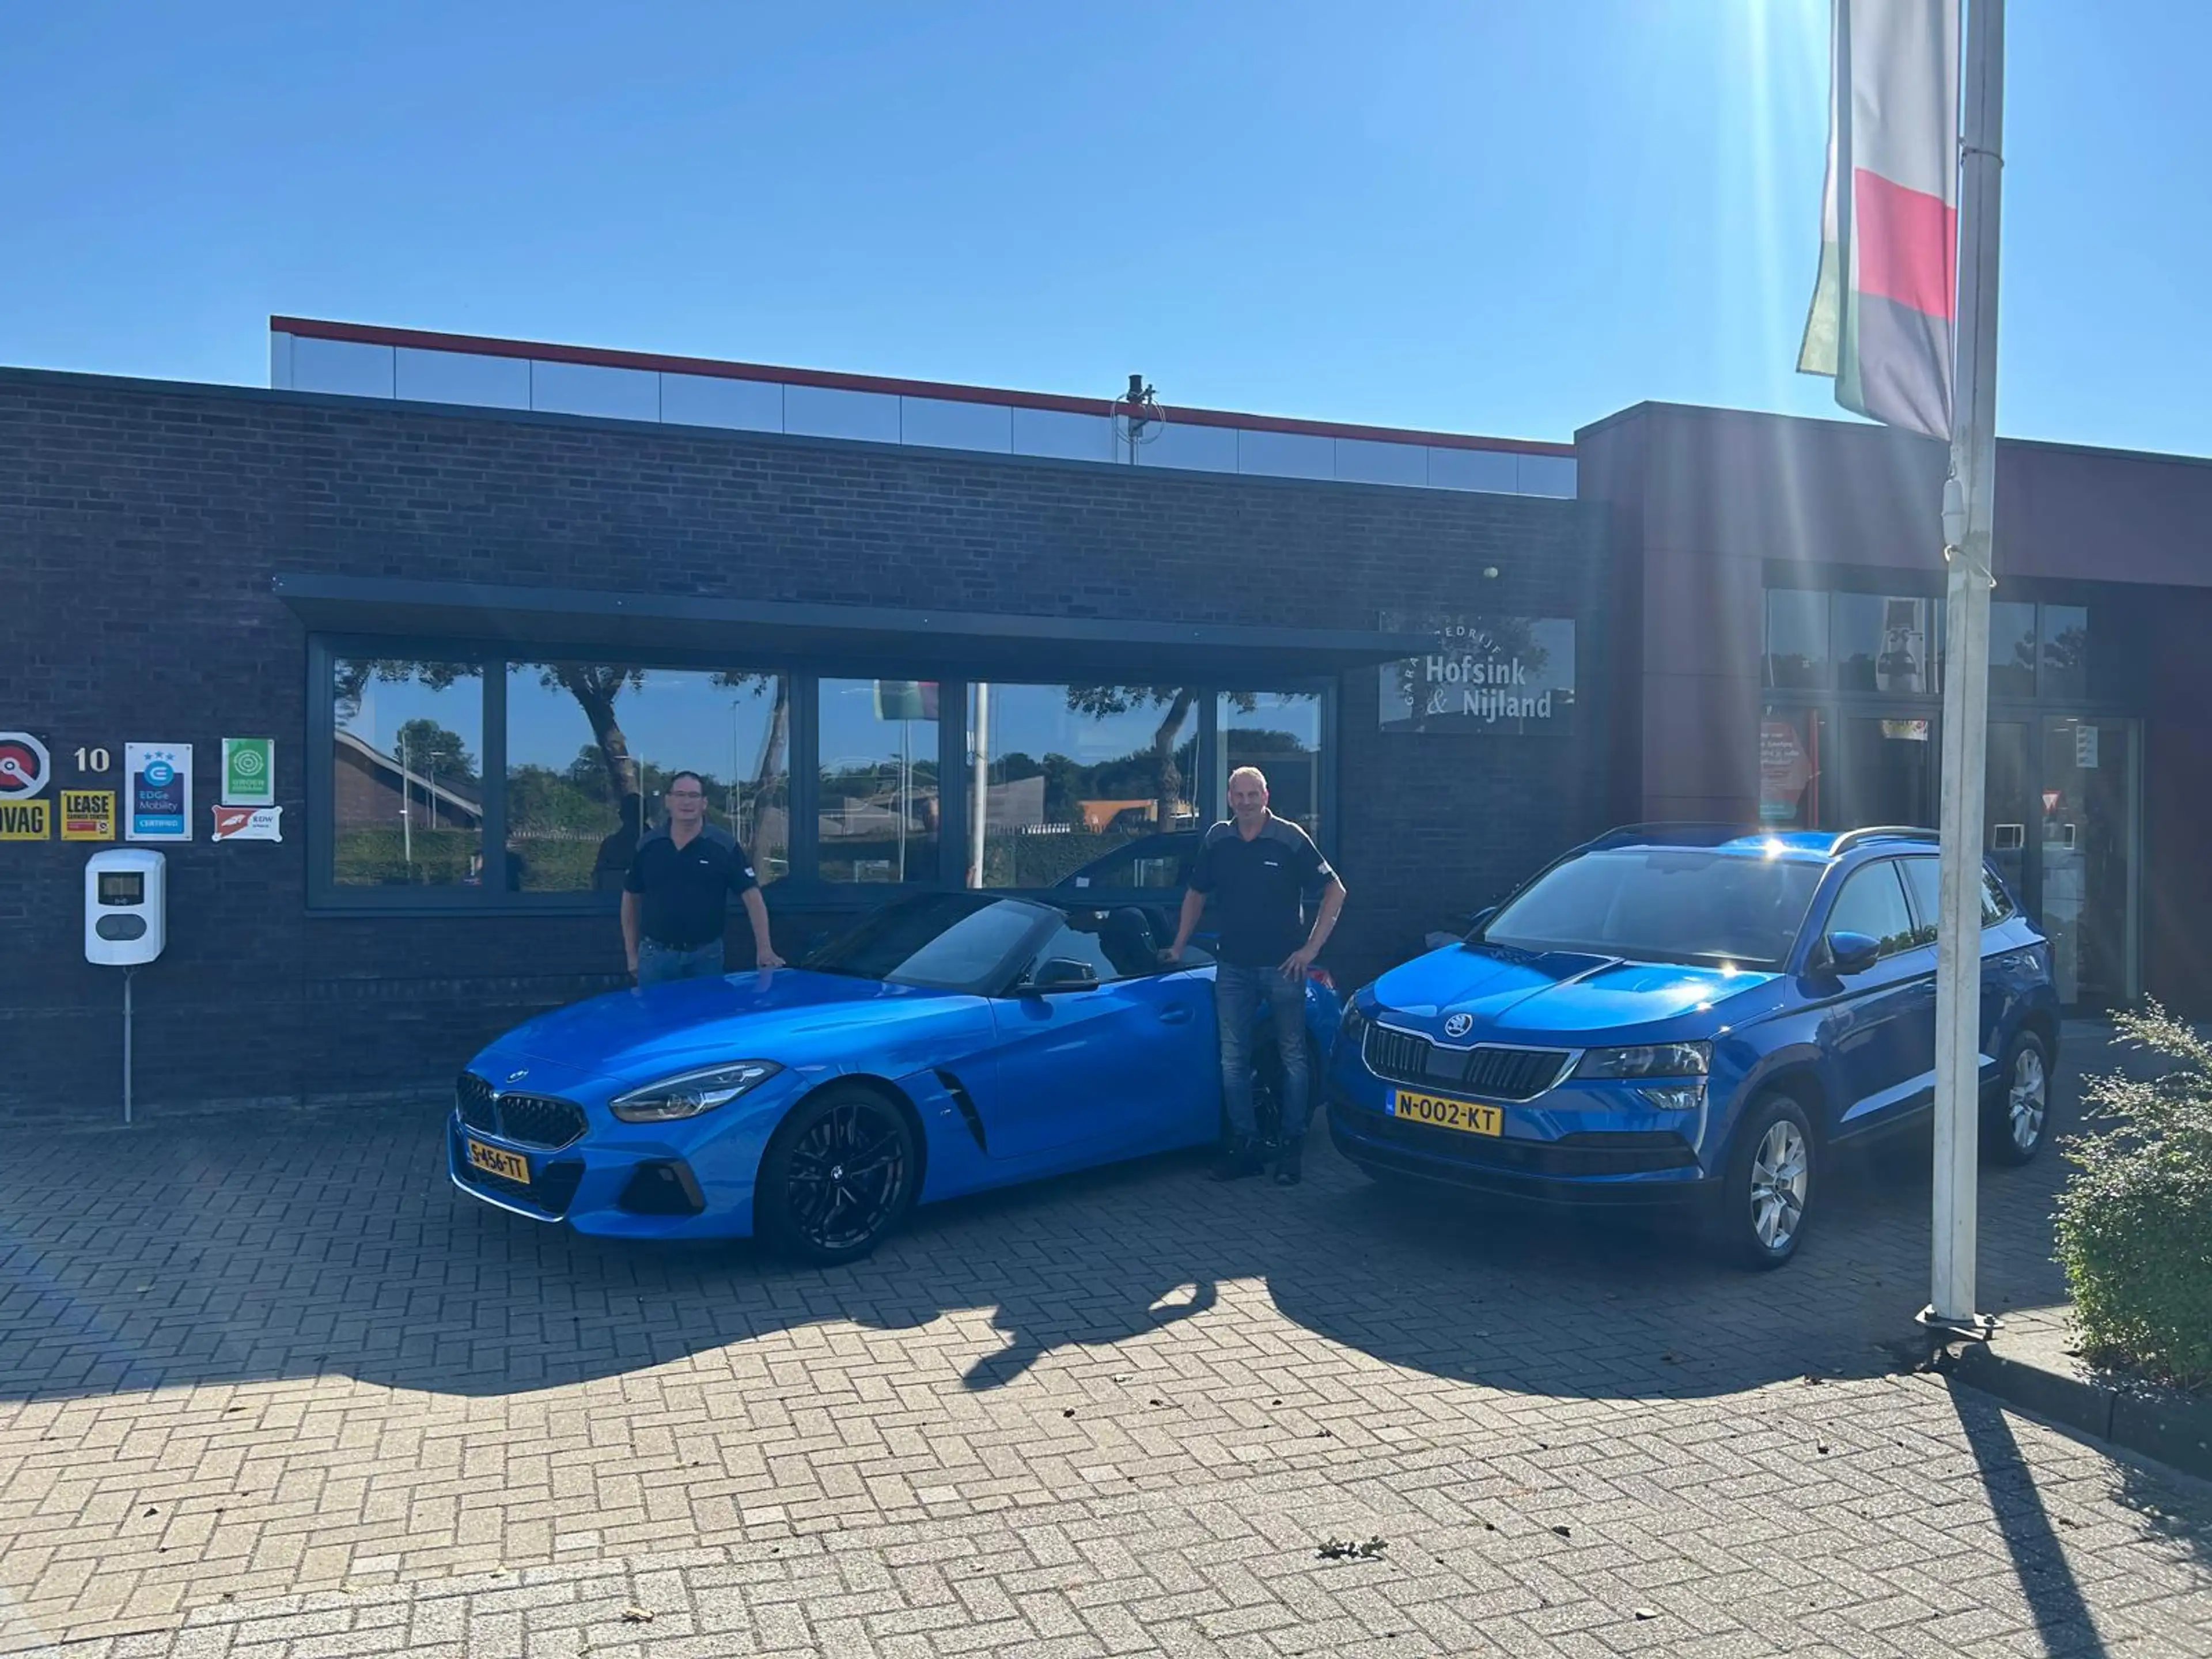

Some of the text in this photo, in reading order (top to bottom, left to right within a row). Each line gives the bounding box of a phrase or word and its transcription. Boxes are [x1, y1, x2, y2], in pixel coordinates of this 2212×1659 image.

[1426, 655, 1526, 685] Hofsink
[1425, 688, 1551, 724] & Nijland
[74, 747, 109, 772] 10
[66, 795, 109, 813] LEASE
[139, 801, 177, 813] Mobility
[1400, 1094, 1495, 1131] N-002-KT
